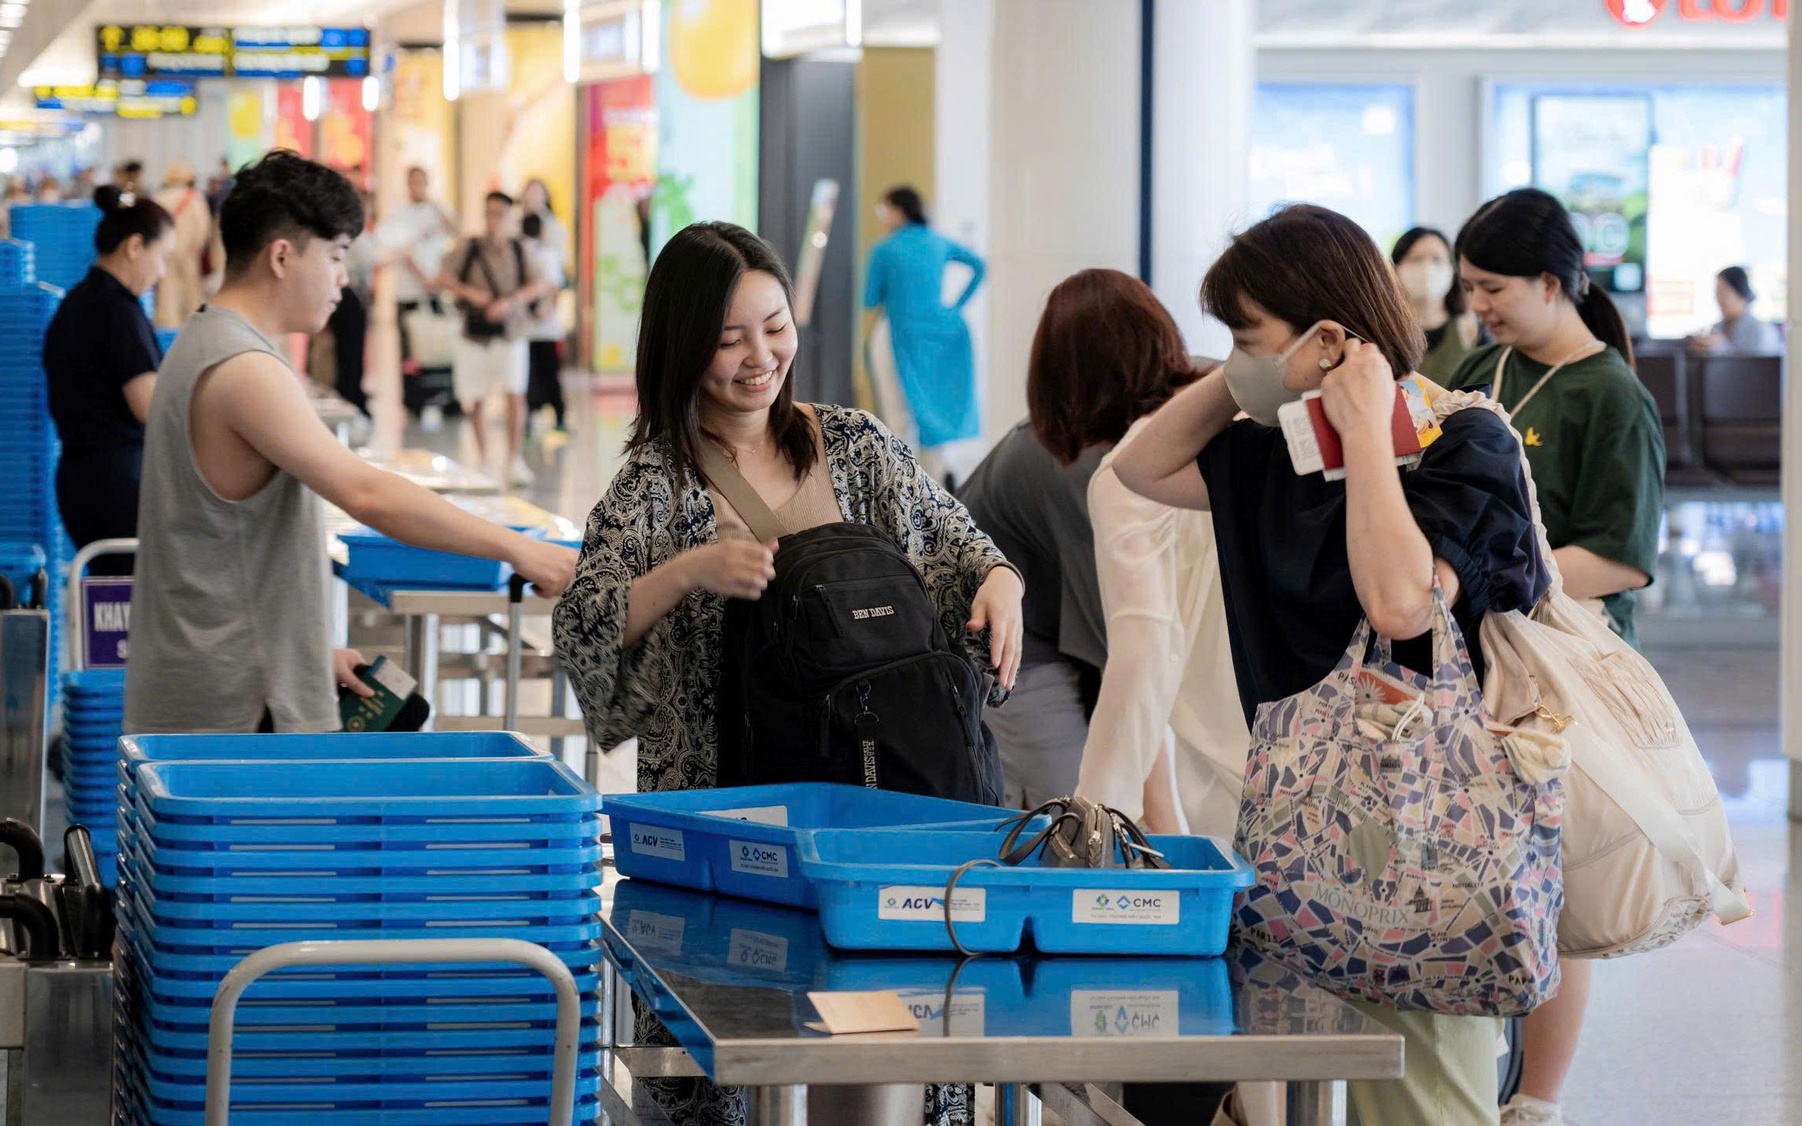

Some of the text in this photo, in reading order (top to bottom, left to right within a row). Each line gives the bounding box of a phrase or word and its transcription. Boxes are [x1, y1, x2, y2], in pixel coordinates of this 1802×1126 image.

[852, 605, 895, 620] BEN DAVIS
[864, 756, 877, 783] DAVIS
[642, 835, 659, 847] ACV
[761, 851, 778, 861] CMC
[902, 898, 934, 909] ACV
[1133, 898, 1161, 908] CMC
